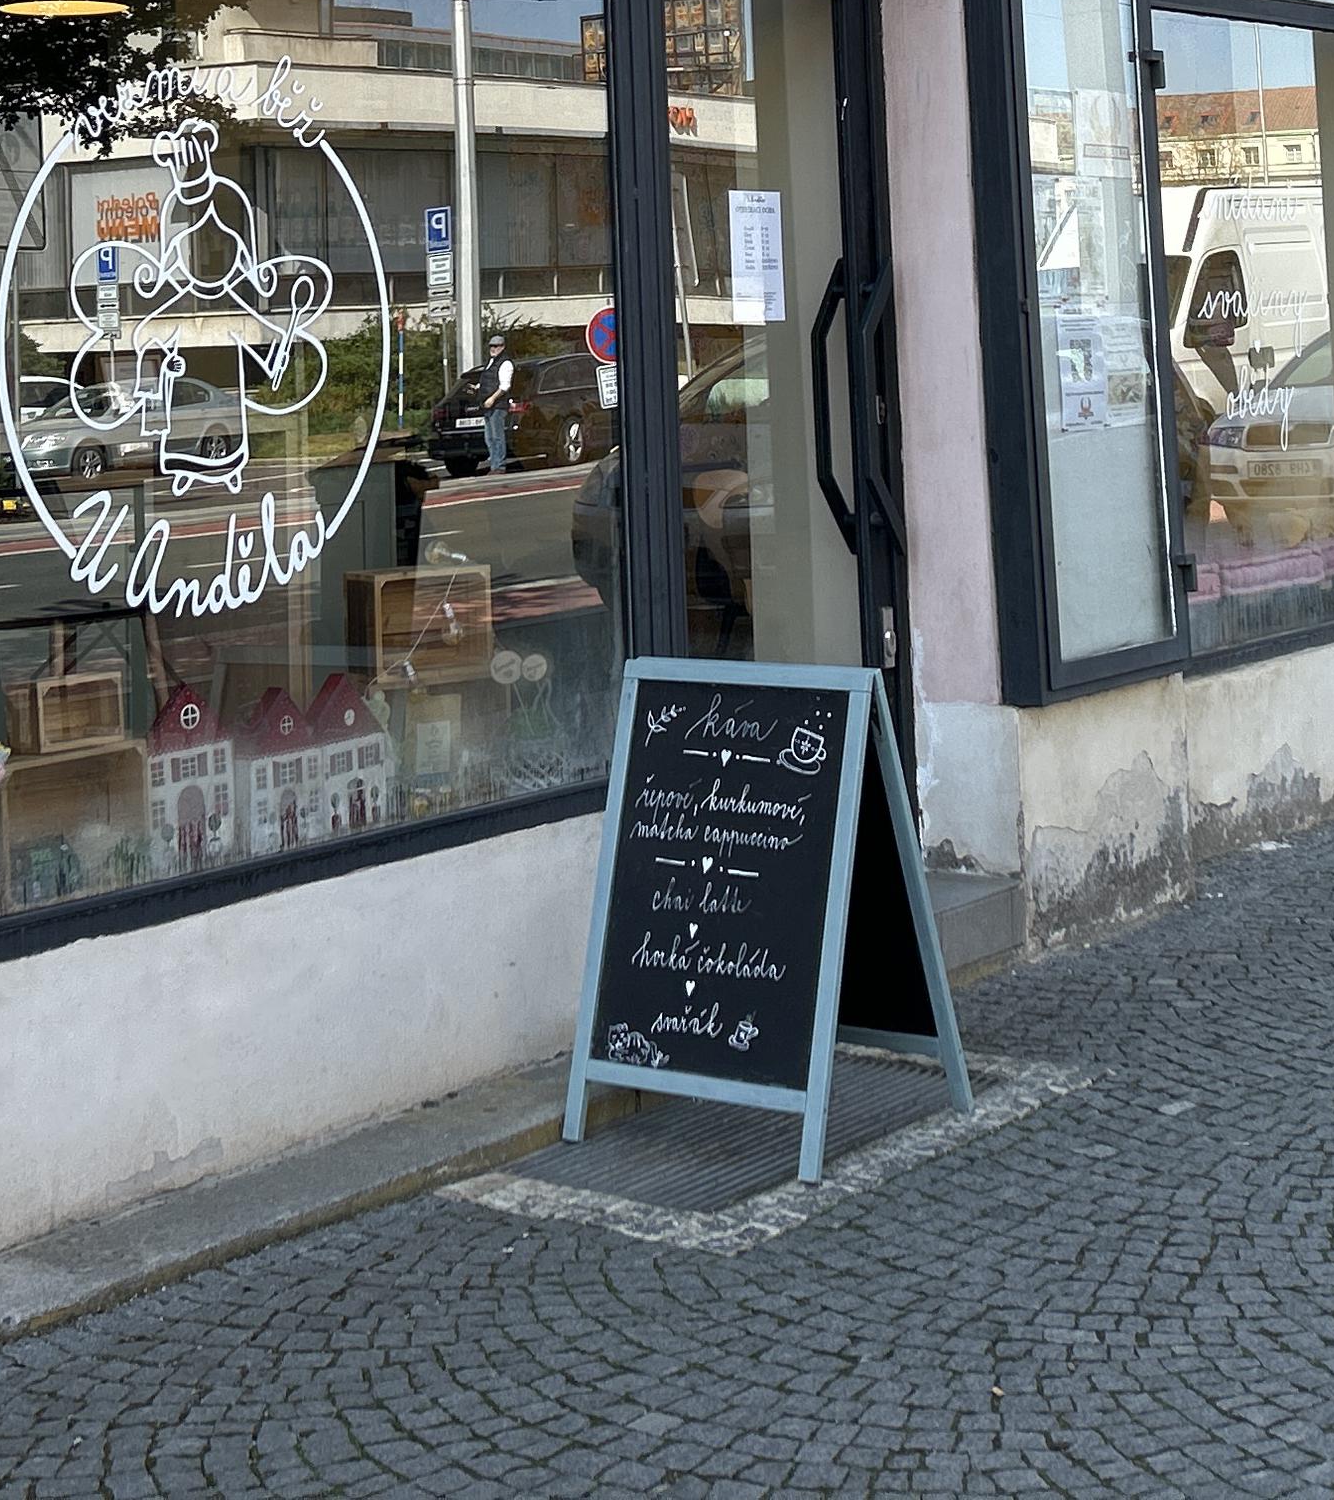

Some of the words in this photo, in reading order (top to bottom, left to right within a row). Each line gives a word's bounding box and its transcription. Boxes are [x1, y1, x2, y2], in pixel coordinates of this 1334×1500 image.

[250, 55, 324, 147] běž
[1226, 364, 1296, 452] obědy
[70, 490, 129, 595] U
[126, 491, 327, 619] Anděla
[683, 693, 778, 742] káva
[701, 778, 811, 827] kurkumové,
[629, 814, 698, 842] matcha
[703, 824, 804, 859] cappuccino
[652, 876, 696, 912] chai
[699, 881, 753, 915] latte
[631, 931, 699, 972] horká
[696, 941, 787, 982] čokoláda
[650, 1002, 724, 1038] svařák
